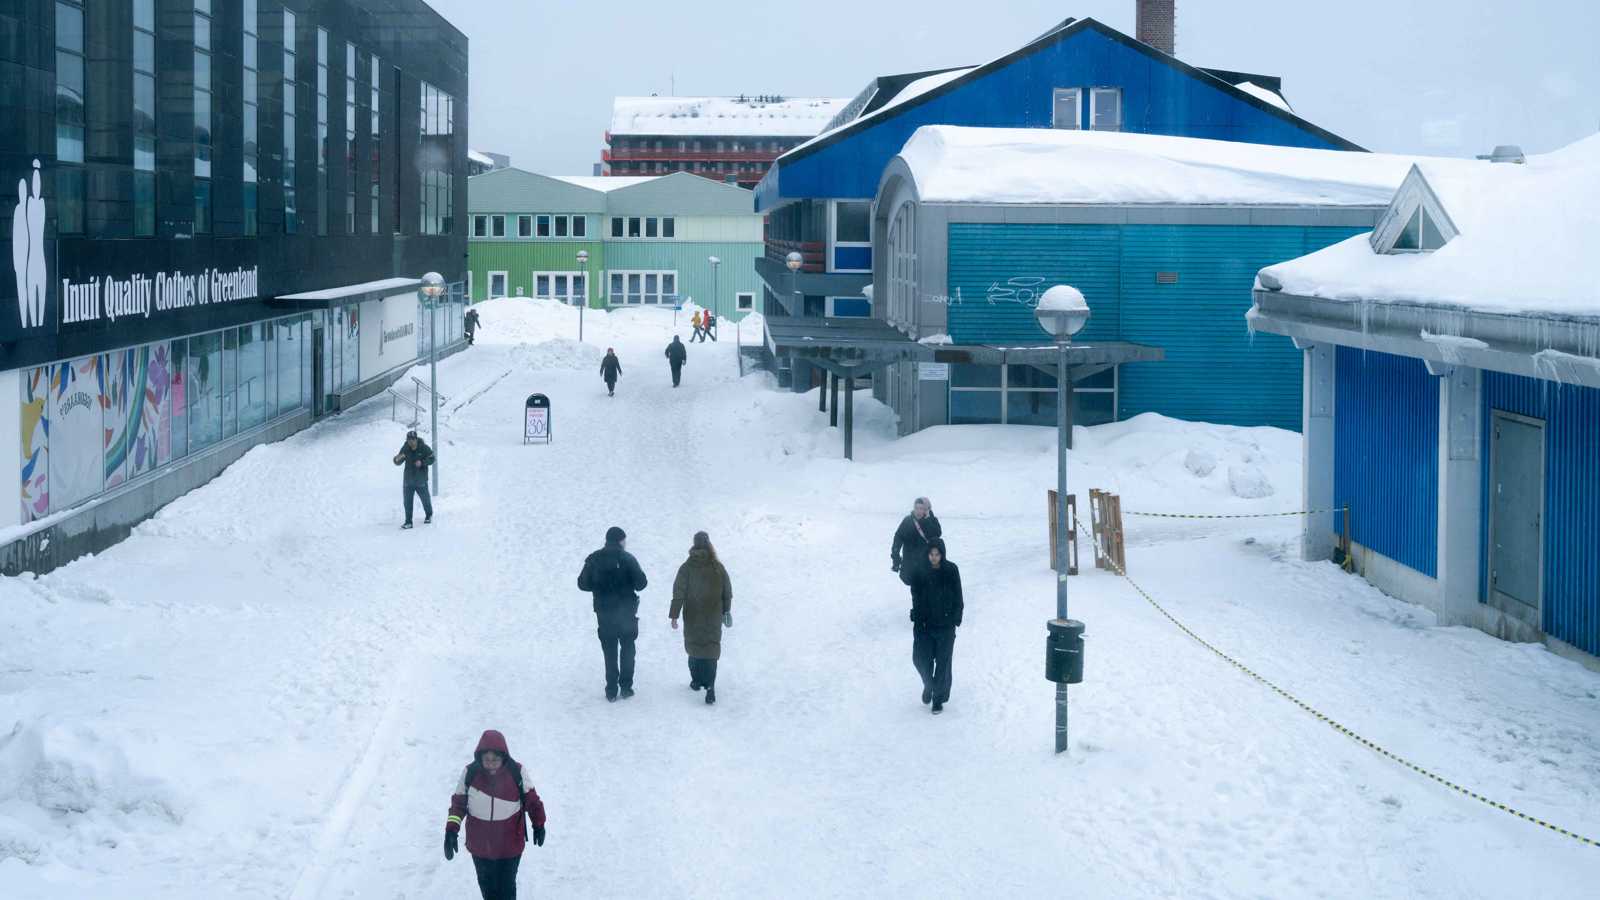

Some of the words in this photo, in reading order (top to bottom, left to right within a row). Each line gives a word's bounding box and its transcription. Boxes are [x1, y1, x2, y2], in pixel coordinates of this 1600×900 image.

[62, 276, 100, 323] Inuit
[104, 274, 152, 322] Quality
[155, 271, 196, 311] Clothes
[198, 268, 209, 304] of
[211, 265, 258, 303] Greenland
